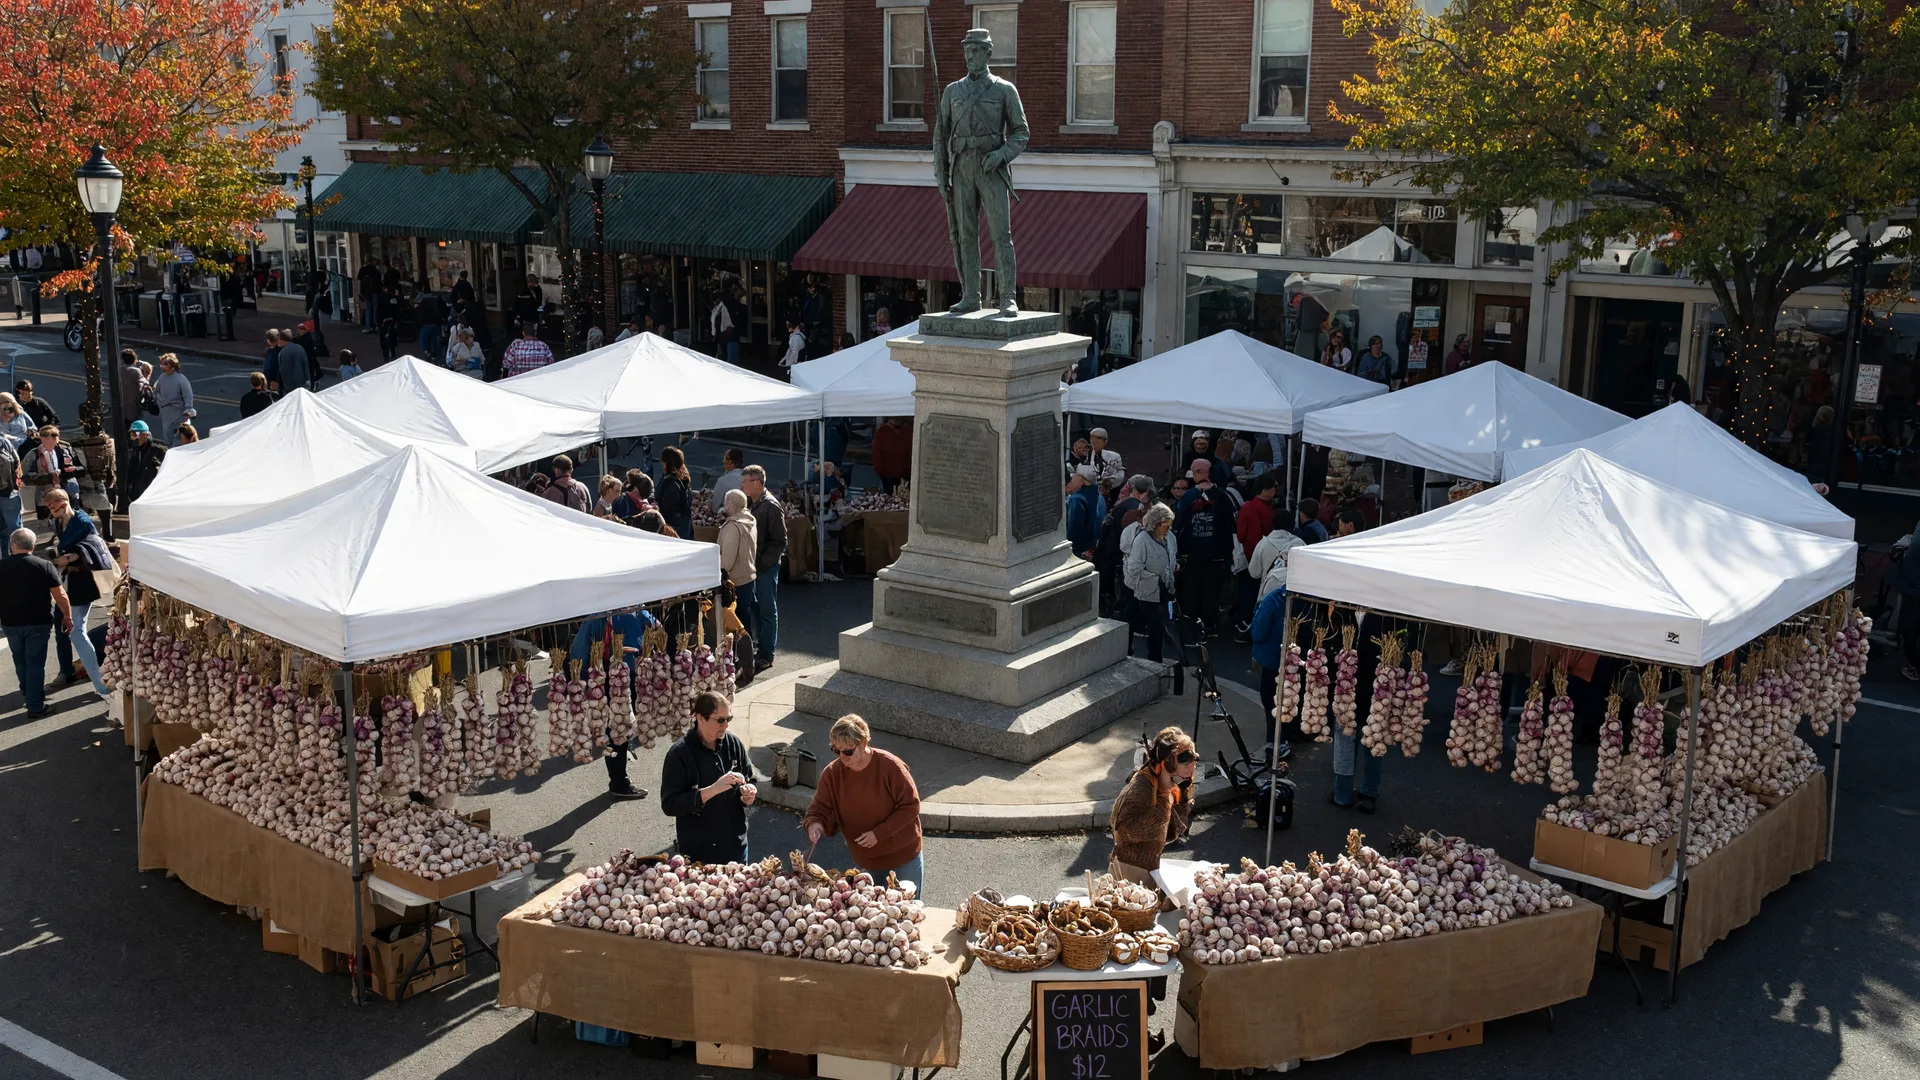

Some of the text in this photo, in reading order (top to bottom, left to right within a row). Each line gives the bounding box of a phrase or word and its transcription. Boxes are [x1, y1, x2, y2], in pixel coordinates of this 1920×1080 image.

[1052, 994, 1130, 1019] GARLIC
[1057, 1023, 1129, 1049] BRAIDS
[1071, 1054, 1111, 1080] $12
